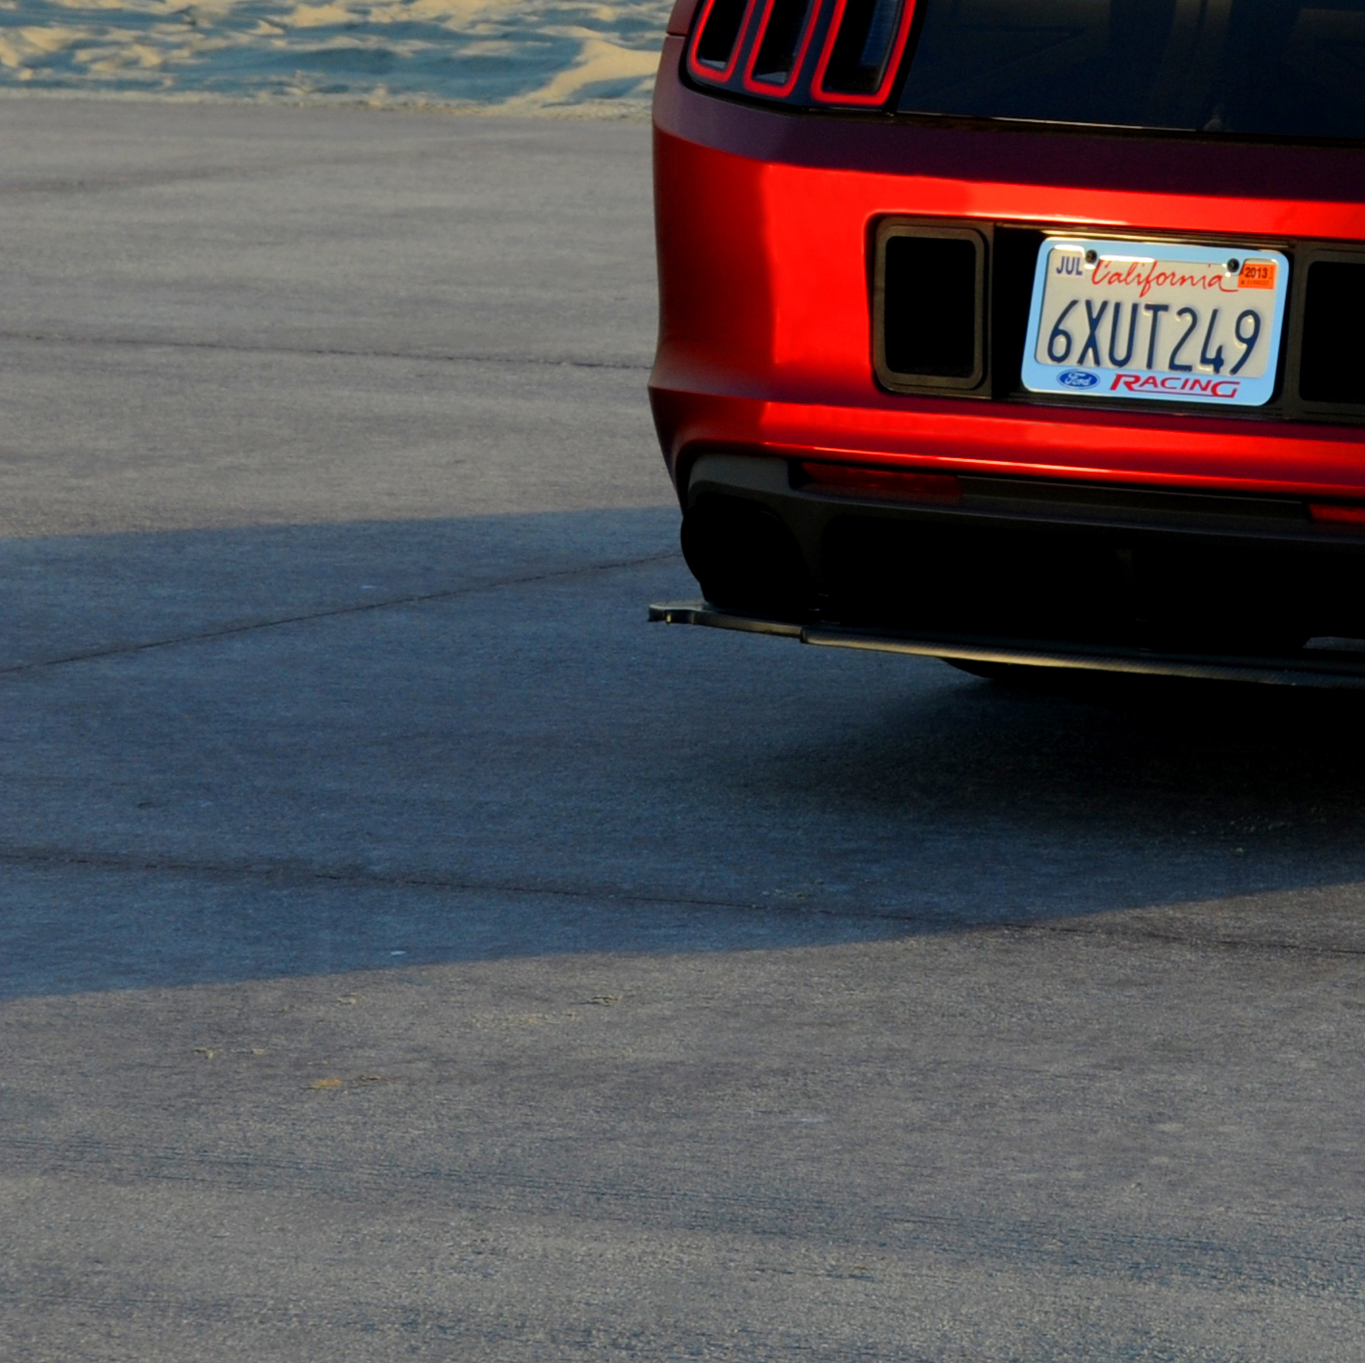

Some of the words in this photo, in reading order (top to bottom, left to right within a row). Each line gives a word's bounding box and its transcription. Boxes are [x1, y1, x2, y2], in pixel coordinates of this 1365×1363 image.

[1056, 255, 1083, 276] JUL
[1091, 259, 1239, 298] California
[1245, 266, 1268, 279] 2013
[1047, 299, 1261, 376] 6XUT249
[1059, 369, 1097, 388] Ford
[1109, 373, 1241, 398] RACING
